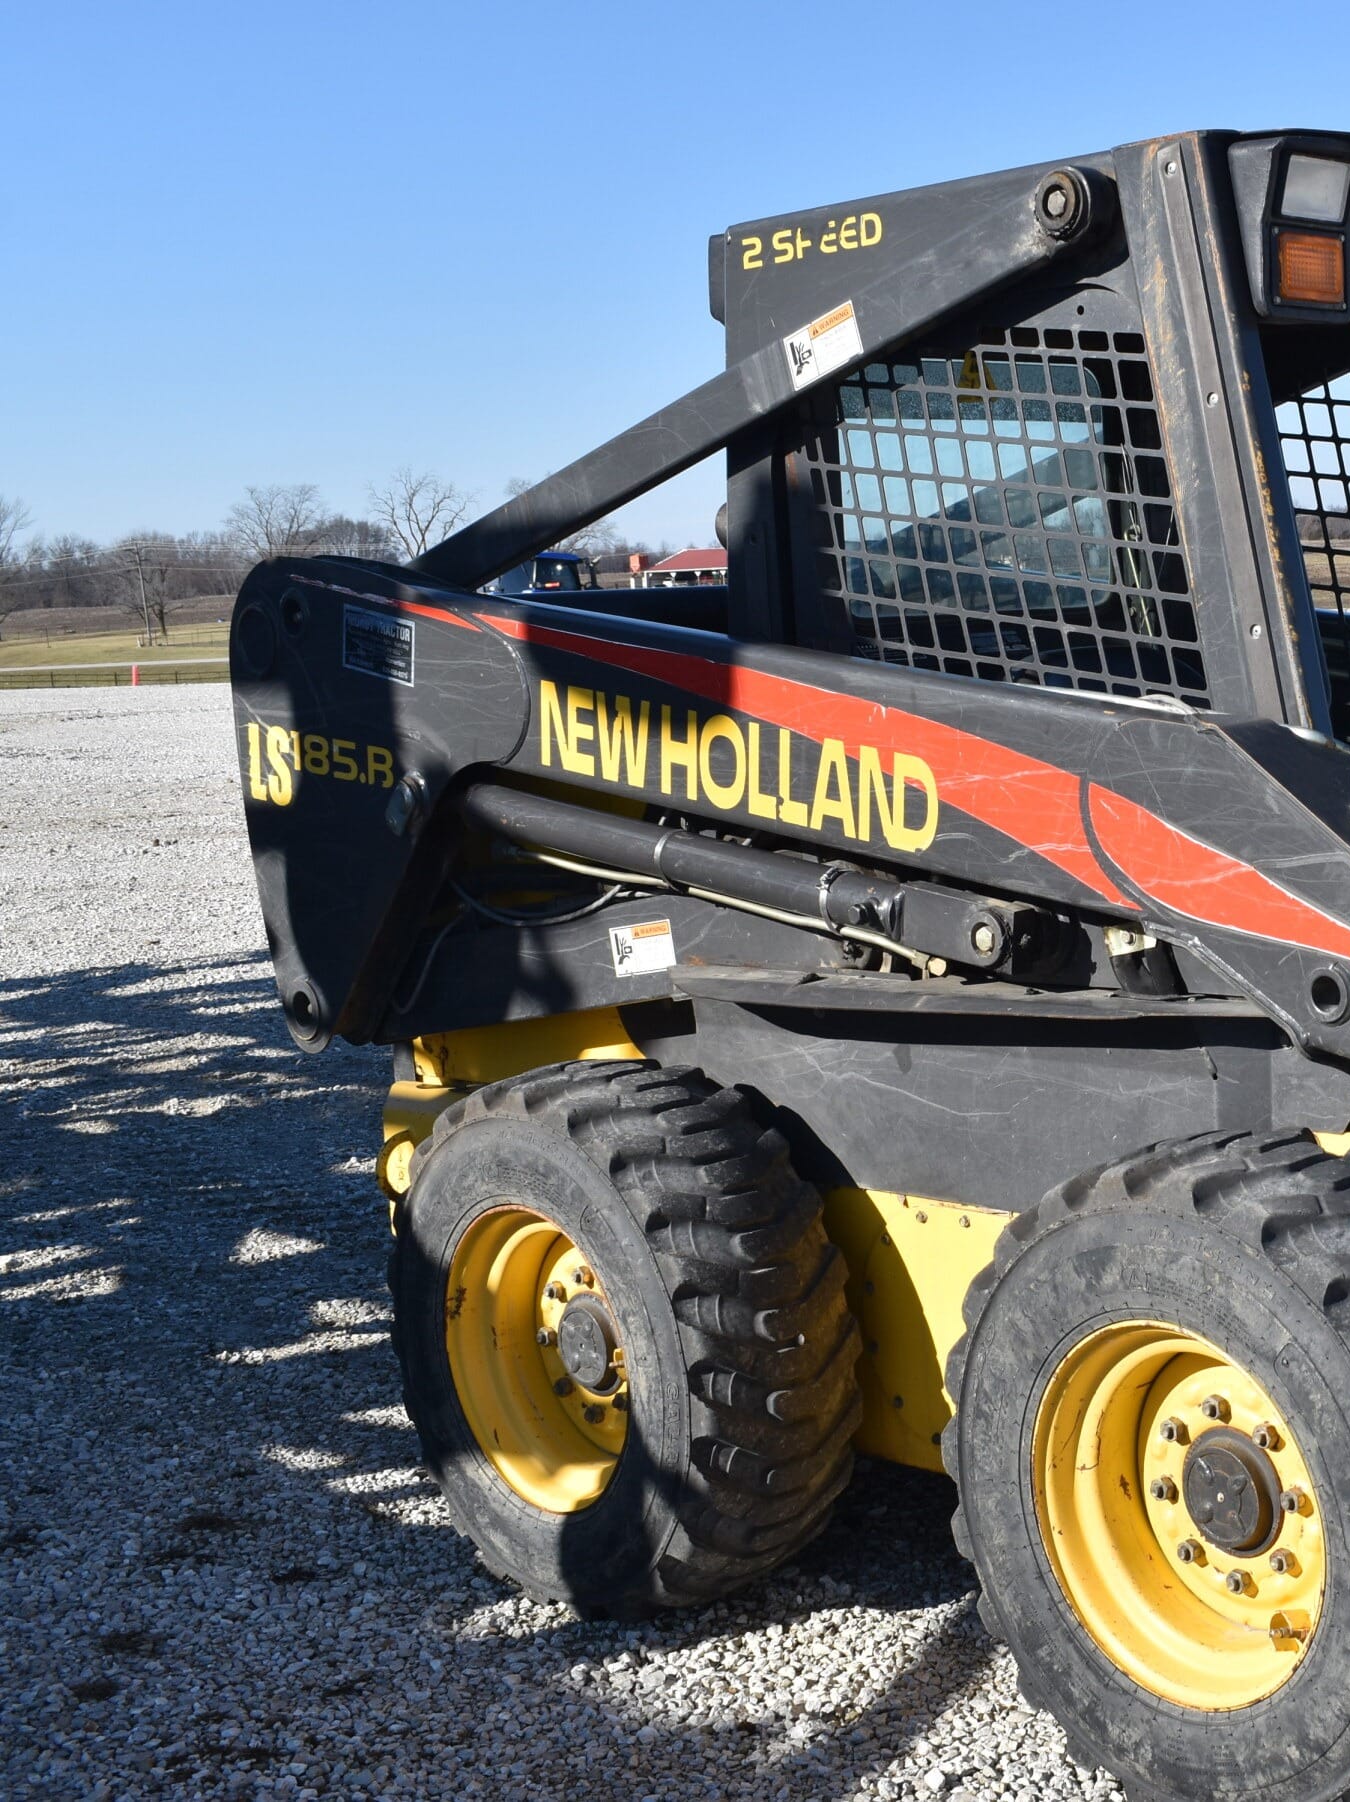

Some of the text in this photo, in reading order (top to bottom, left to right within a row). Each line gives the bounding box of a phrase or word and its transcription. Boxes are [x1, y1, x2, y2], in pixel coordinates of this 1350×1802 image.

[742, 236, 763, 270] 2
[540, 679, 939, 854] NEW HOLLAND
